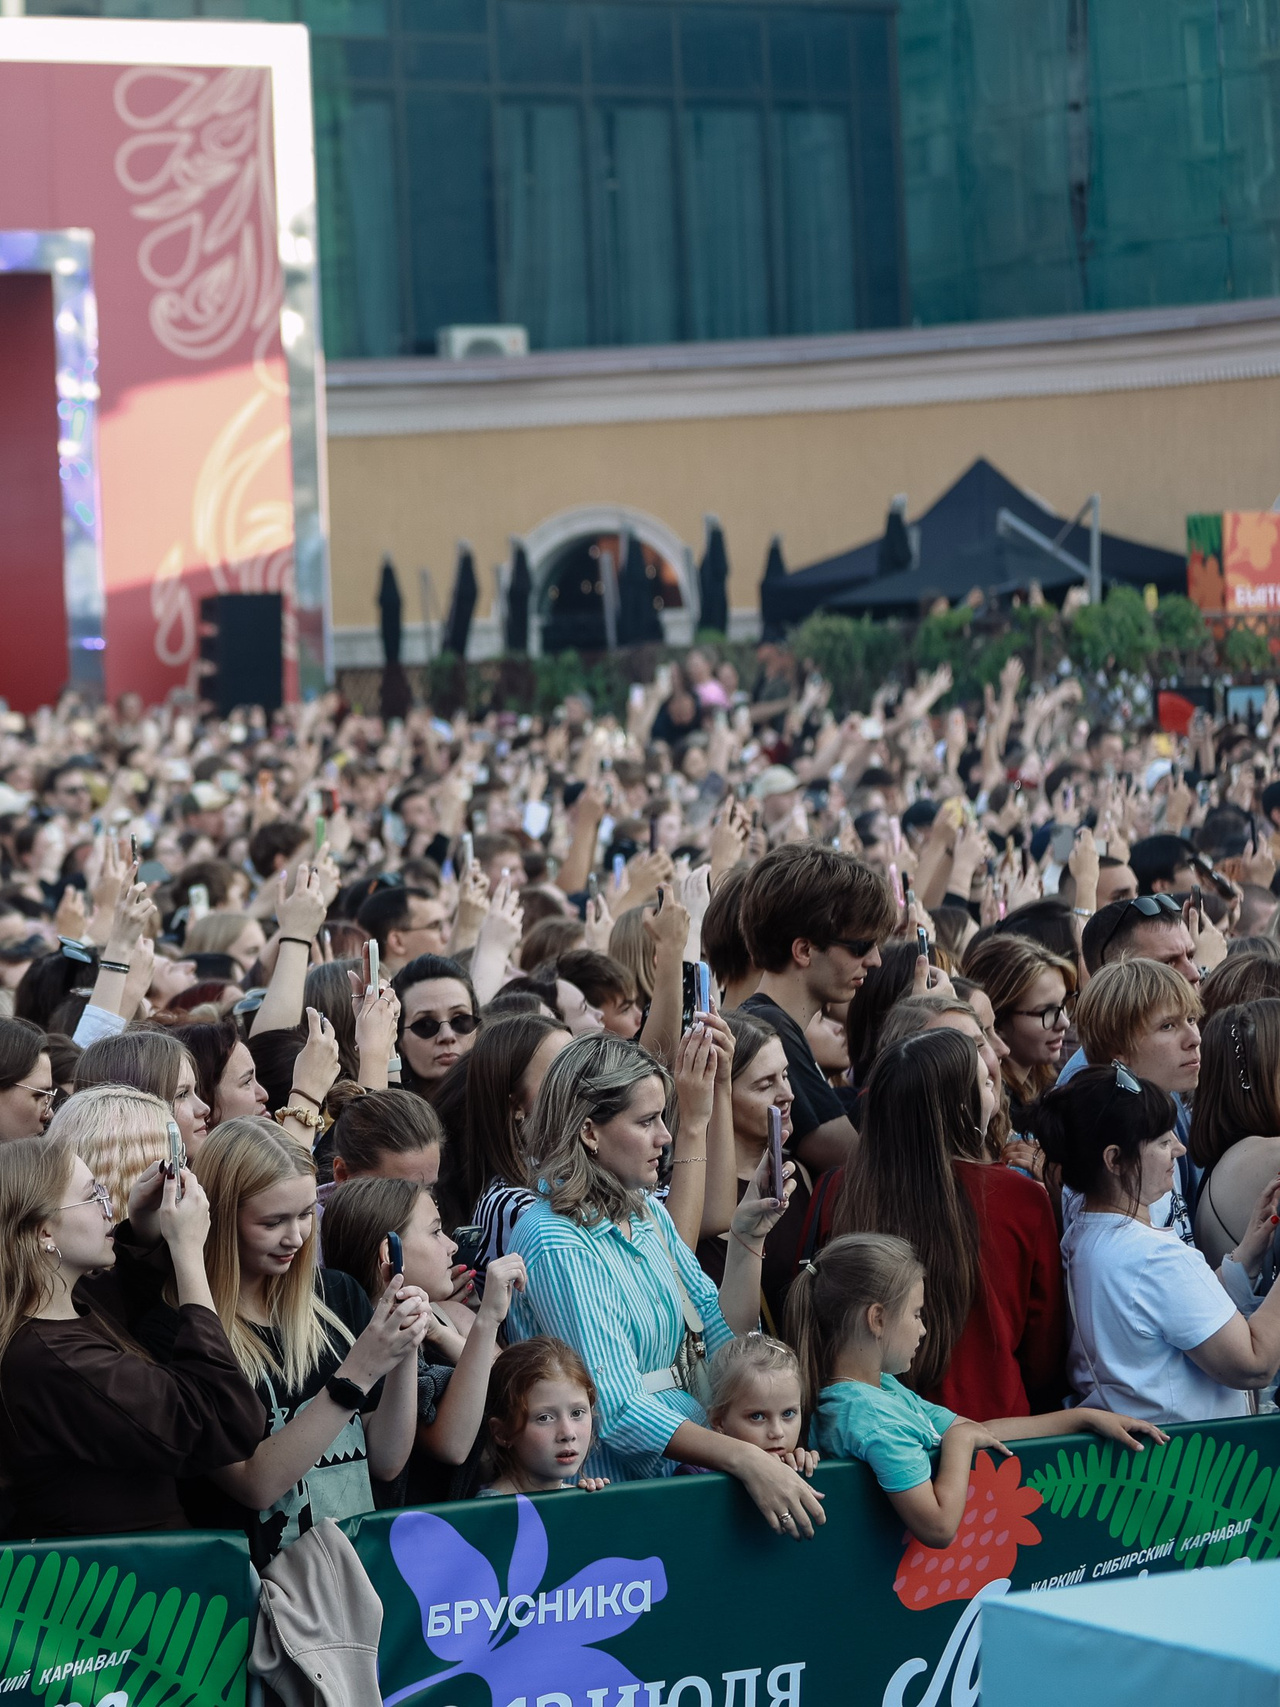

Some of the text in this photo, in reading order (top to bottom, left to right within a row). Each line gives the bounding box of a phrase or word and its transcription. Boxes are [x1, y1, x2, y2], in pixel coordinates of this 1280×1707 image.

[1092, 1538, 1175, 1578] СИБИРСКИЙ
[1180, 1518, 1252, 1552] КАРНАВАЛ
[426, 1579, 652, 1638] БРУСНИКА
[38, 1648, 132, 1686] КАРНАВАЛ
